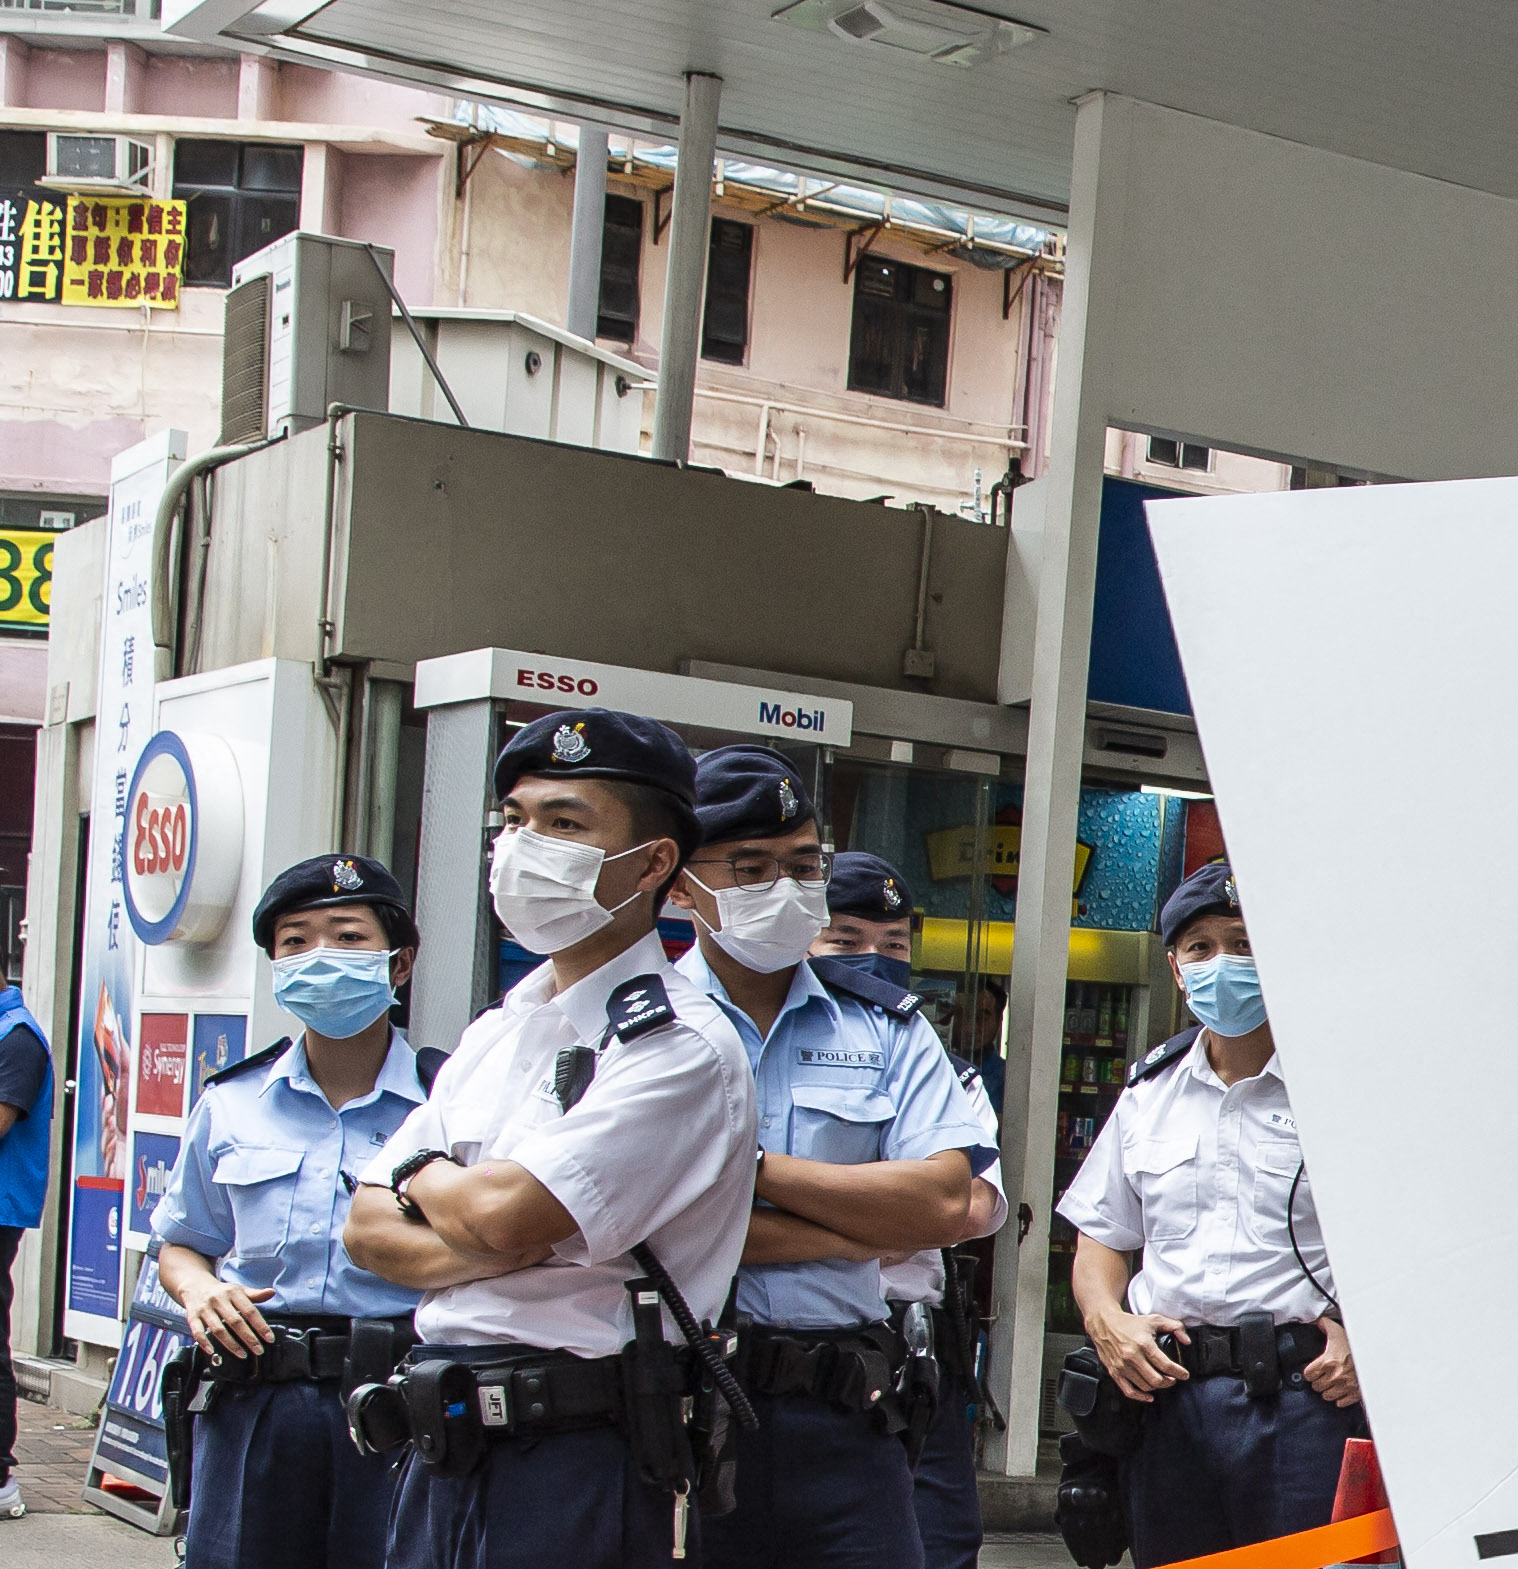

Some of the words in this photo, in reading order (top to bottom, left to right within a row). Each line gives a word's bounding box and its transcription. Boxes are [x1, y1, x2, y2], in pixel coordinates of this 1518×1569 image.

[18, 200, 63, 299] 售
[516, 668, 599, 697] ESSO
[758, 701, 825, 732] Mobil
[134, 791, 187, 876] Esso
[153, 1048, 185, 1085] Synergy
[816, 1052, 866, 1063] POLICE
